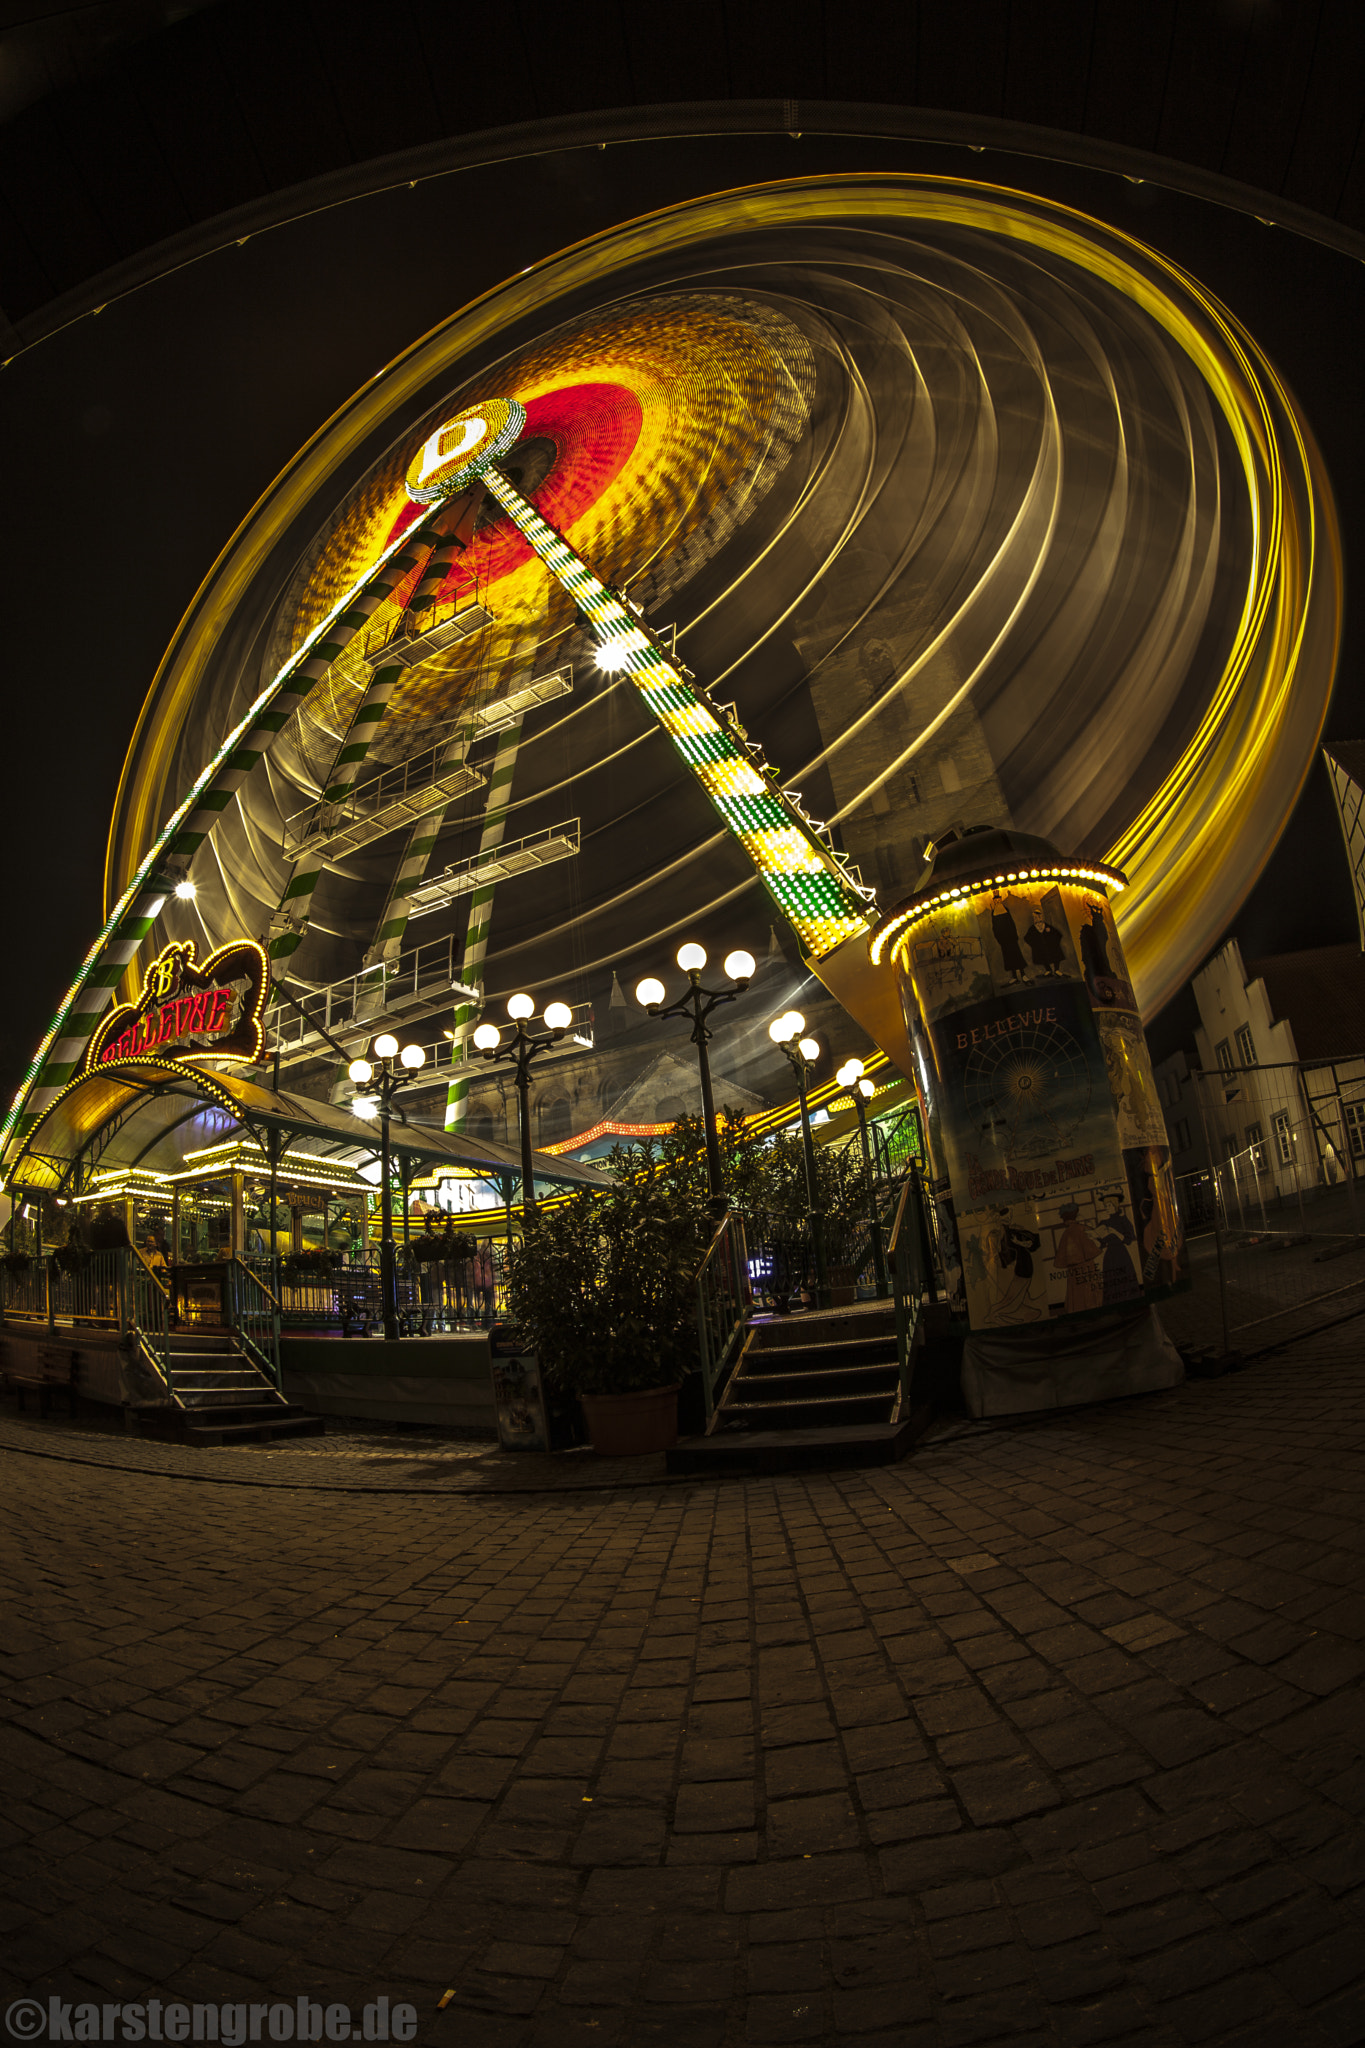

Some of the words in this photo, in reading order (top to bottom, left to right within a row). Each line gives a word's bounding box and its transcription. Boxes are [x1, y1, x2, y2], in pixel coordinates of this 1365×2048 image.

[155, 956, 179, 998] B
[101, 989, 235, 1063] BELLEVUE
[956, 1007, 1058, 1050] BELLEVUE
[965, 1152, 983, 1176] LA
[967, 1168, 1009, 1201] GRANDE
[1006, 1165, 1043, 1192] ROUE
[1041, 1170, 1059, 1187] DE
[1056, 1154, 1096, 1182] PARIS
[285, 1191, 325, 1210] Bruch
[1049, 1263, 1101, 1281] NOUVELLE
